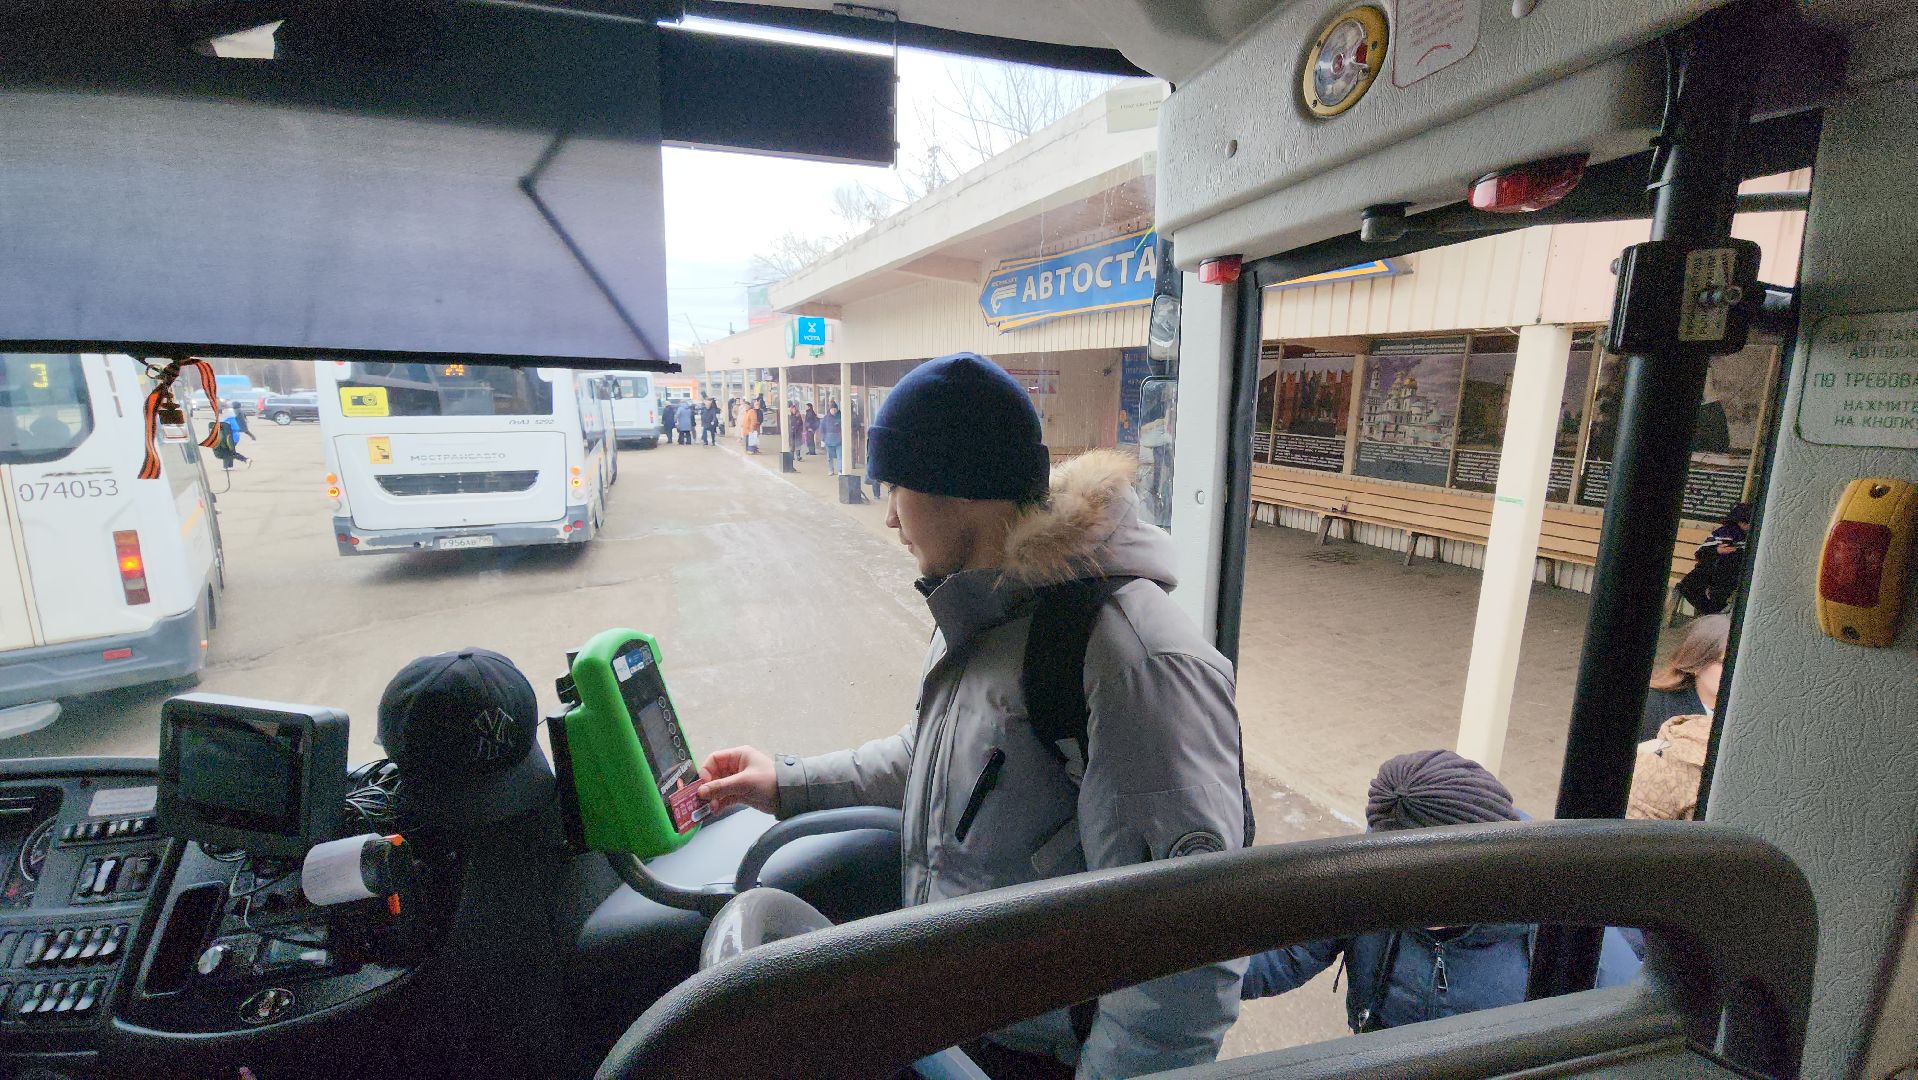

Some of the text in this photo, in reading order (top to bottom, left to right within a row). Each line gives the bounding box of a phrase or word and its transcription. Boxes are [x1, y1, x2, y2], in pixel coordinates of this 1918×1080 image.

[1021, 245, 1157, 303] АВТОСТА
[1813, 372, 1836, 388] ПО
[1833, 415, 1918, 430] НА КНОПК
[18, 478, 119, 502] 074053
